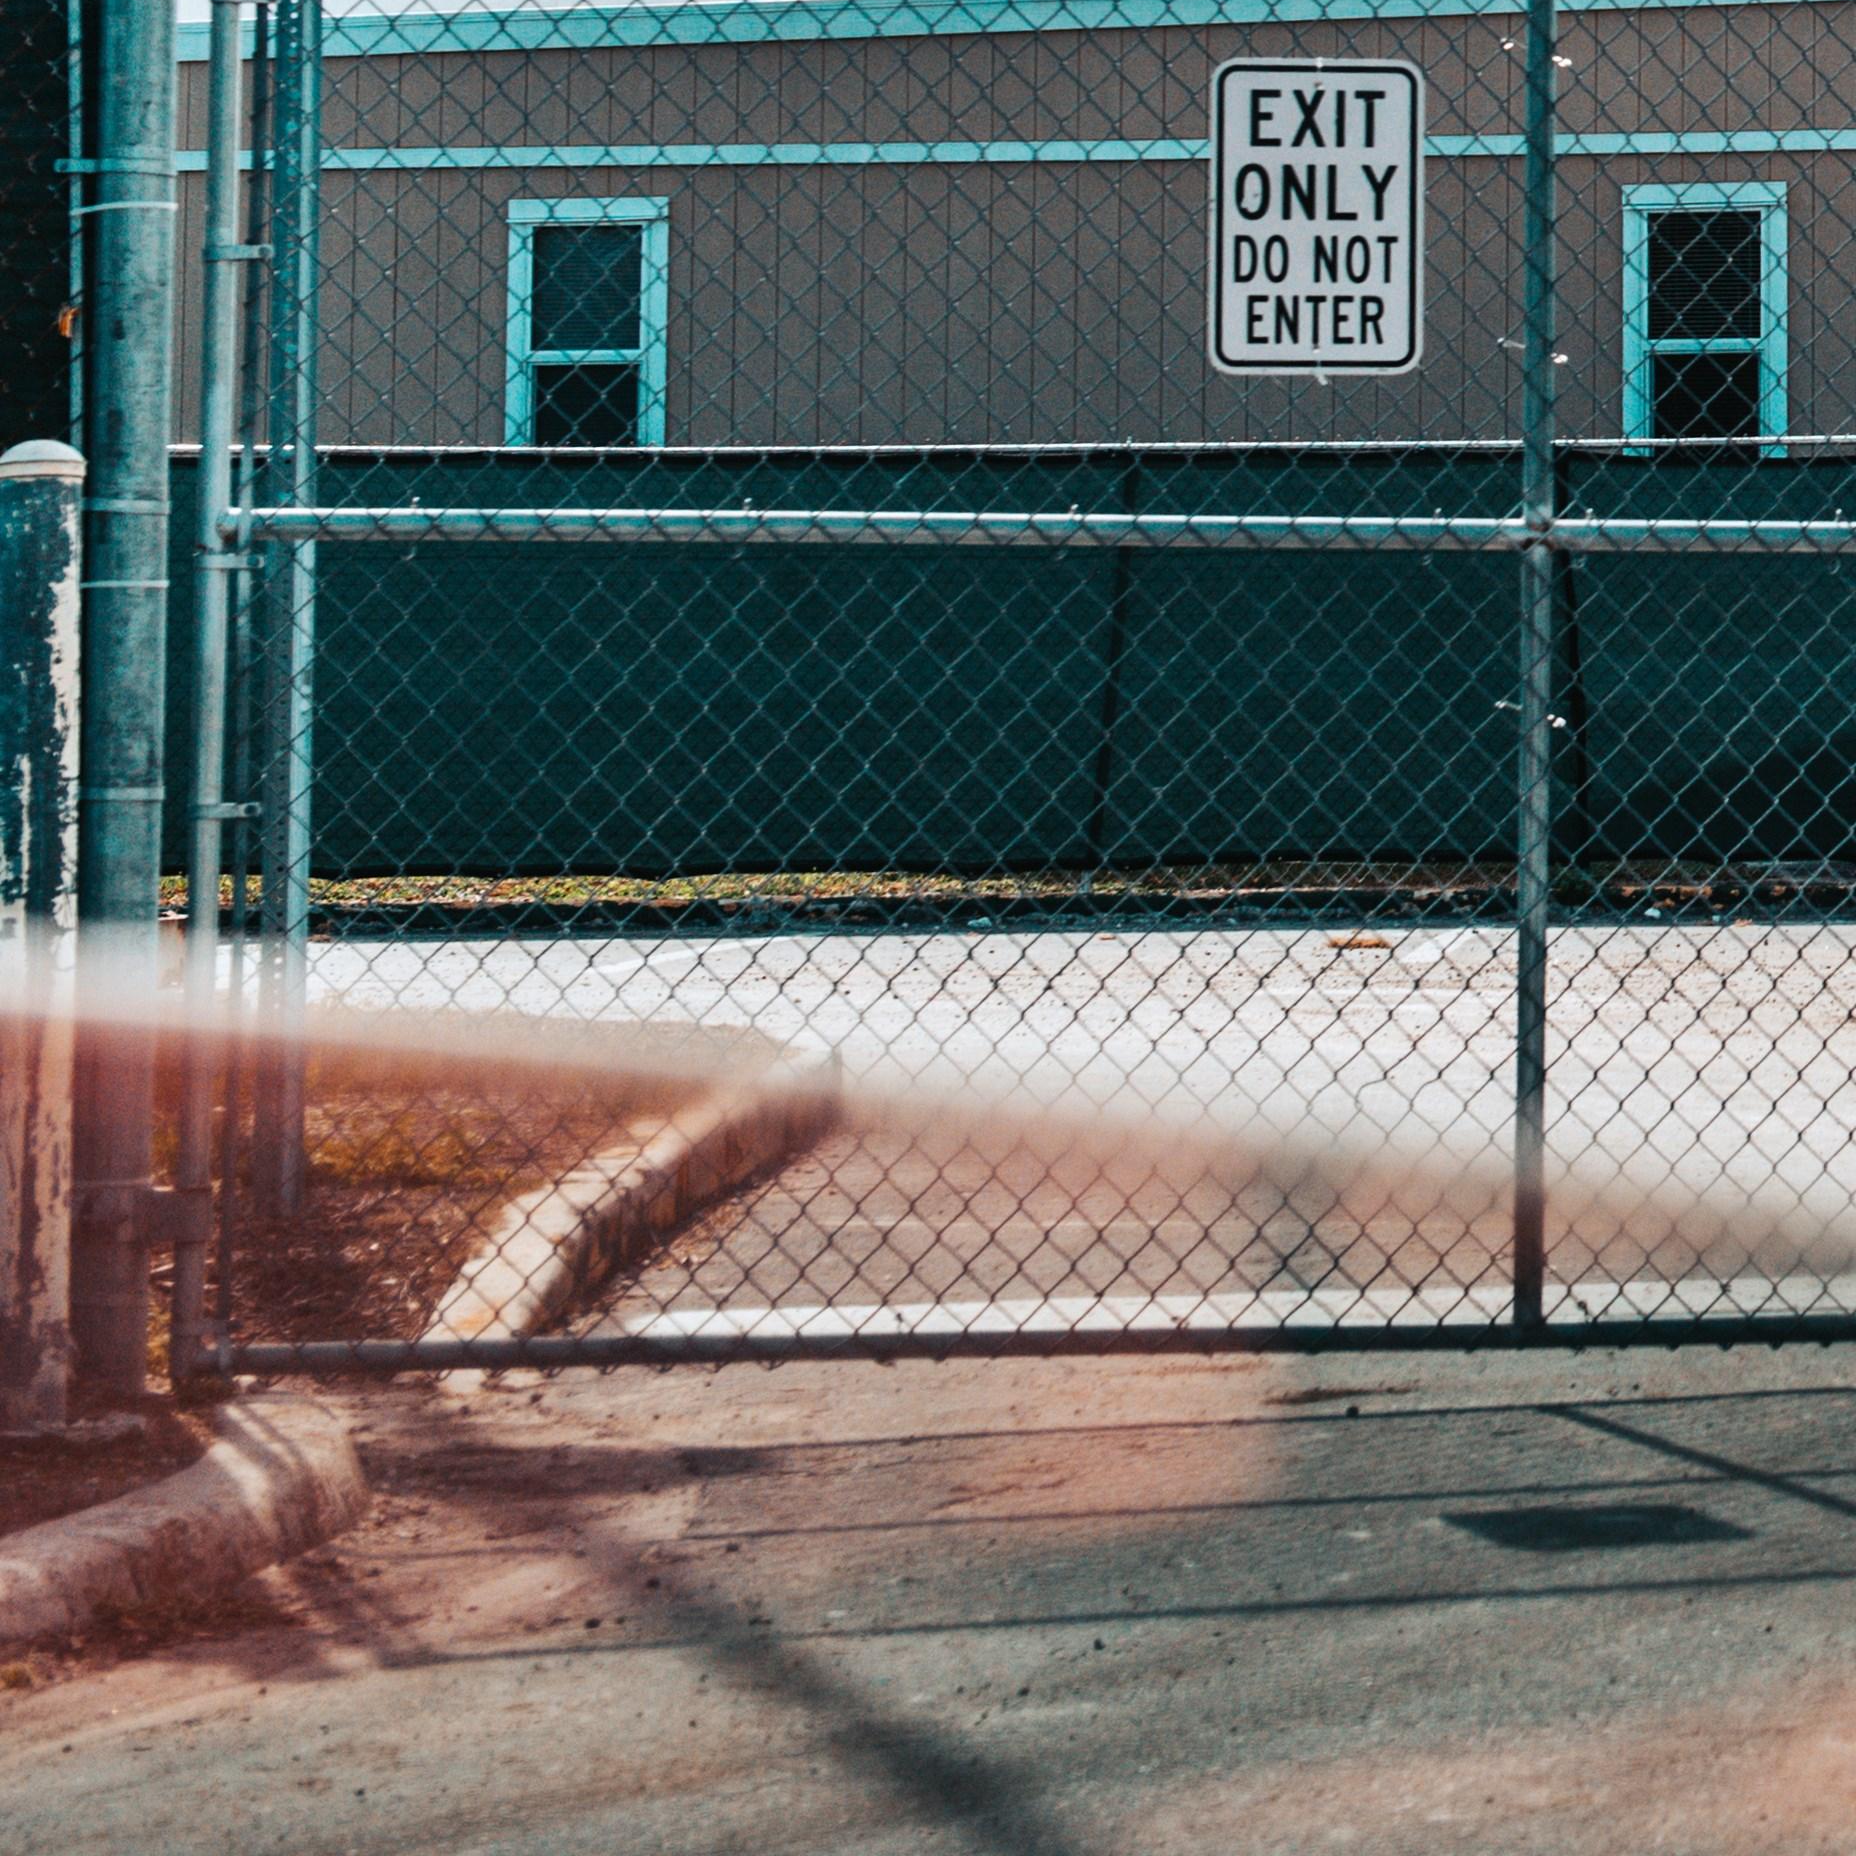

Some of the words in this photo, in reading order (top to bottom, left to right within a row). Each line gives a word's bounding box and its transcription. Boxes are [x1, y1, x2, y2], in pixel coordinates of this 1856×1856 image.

[1250, 89, 1386, 148] EXIT
[1235, 163, 1398, 221] ONLY
[1234, 235, 1289, 283] DO
[1314, 235, 1398, 283] NOT
[1247, 295, 1384, 345] ENTER
